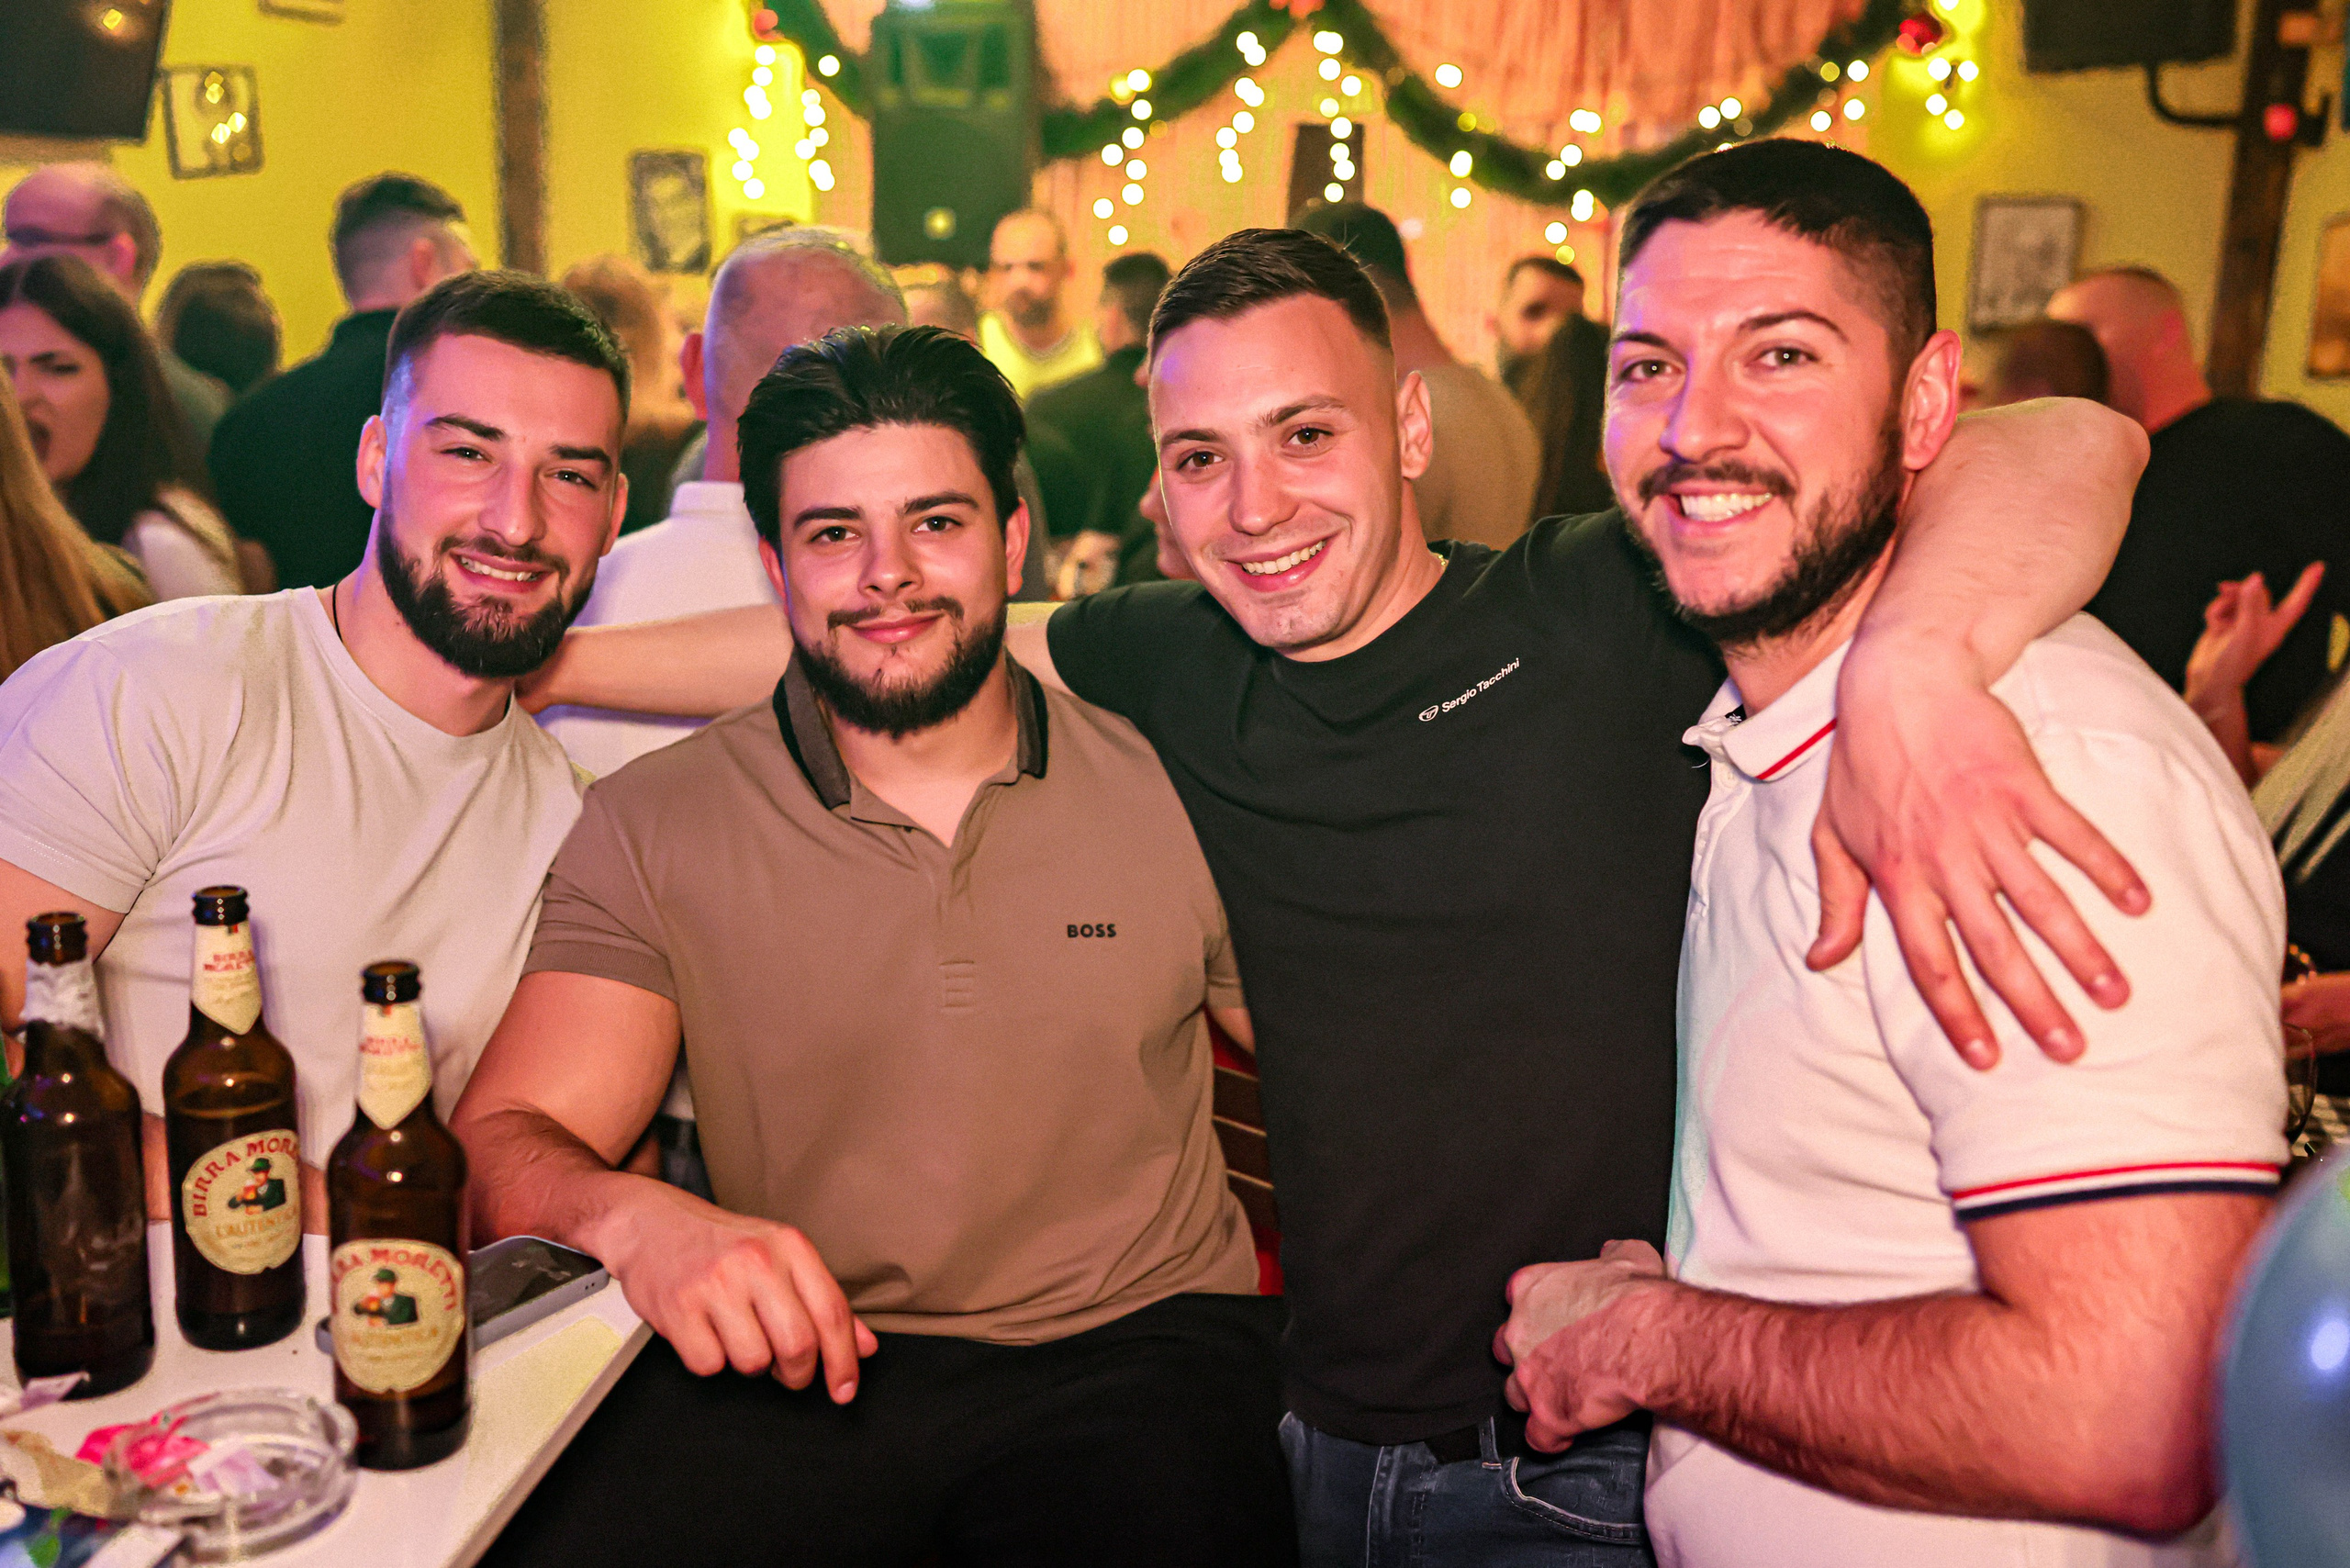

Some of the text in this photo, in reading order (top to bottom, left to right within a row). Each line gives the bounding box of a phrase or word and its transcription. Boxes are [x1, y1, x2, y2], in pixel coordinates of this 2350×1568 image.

[1441, 657, 1520, 713] Sergio Tacchini
[1067, 924, 1117, 938] BOSS
[193, 1150, 242, 1217] BIRRA
[370, 1249, 458, 1311] MORETTI
